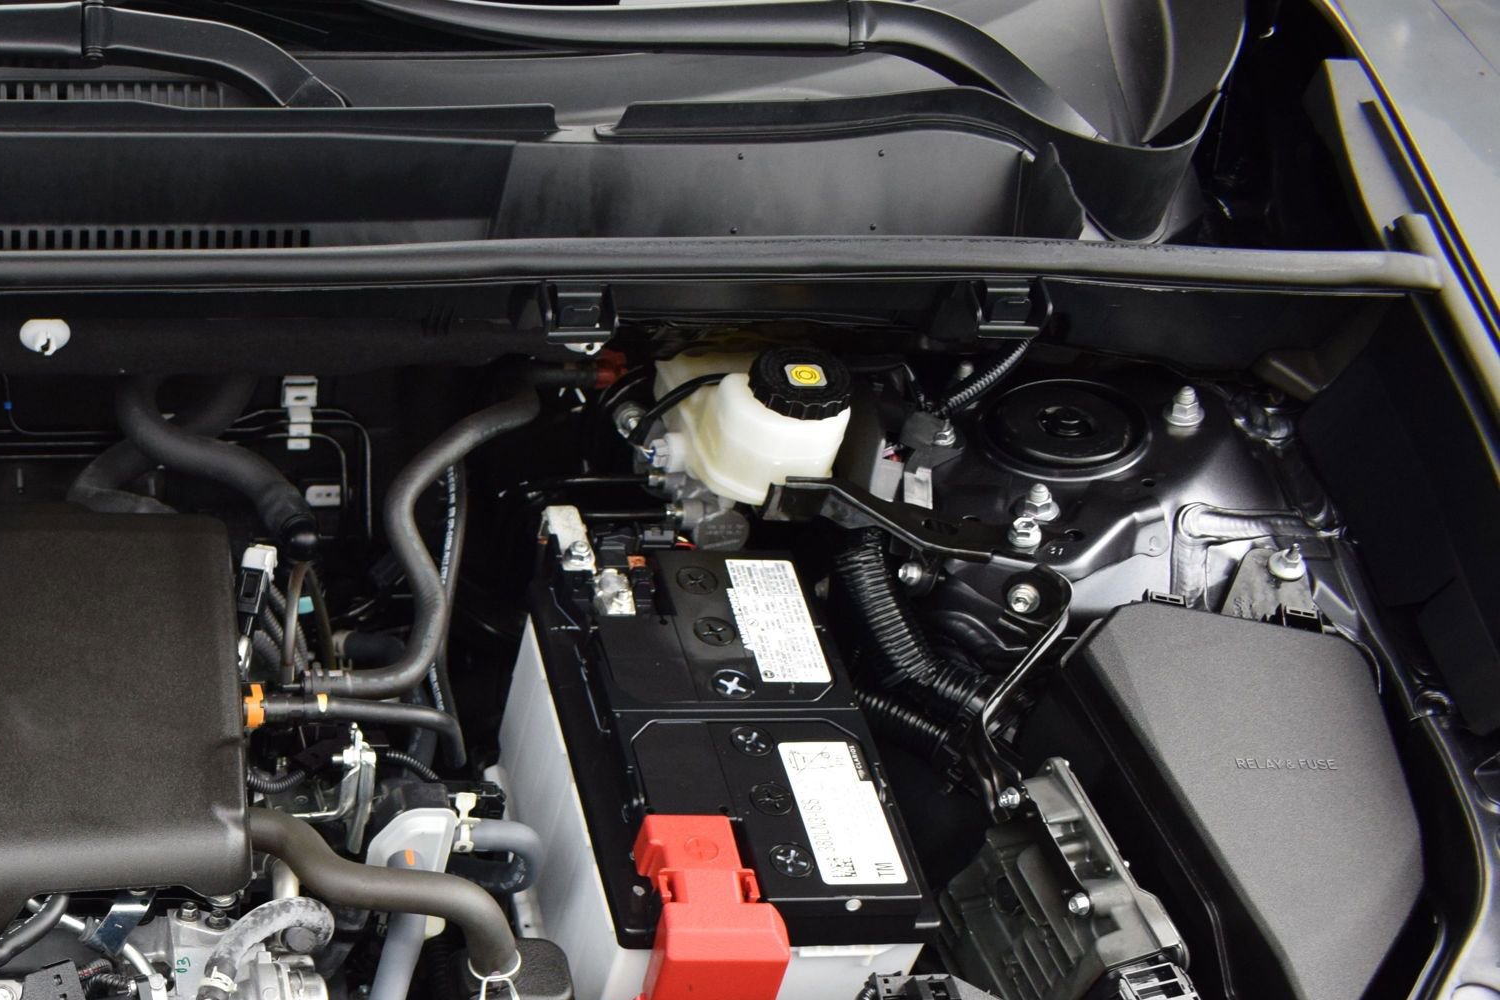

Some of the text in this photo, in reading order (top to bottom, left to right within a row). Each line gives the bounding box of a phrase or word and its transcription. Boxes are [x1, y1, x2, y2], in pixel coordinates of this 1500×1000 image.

[1235, 758, 1339, 771] RELAY & FUSE
[874, 862, 897, 878] TM
